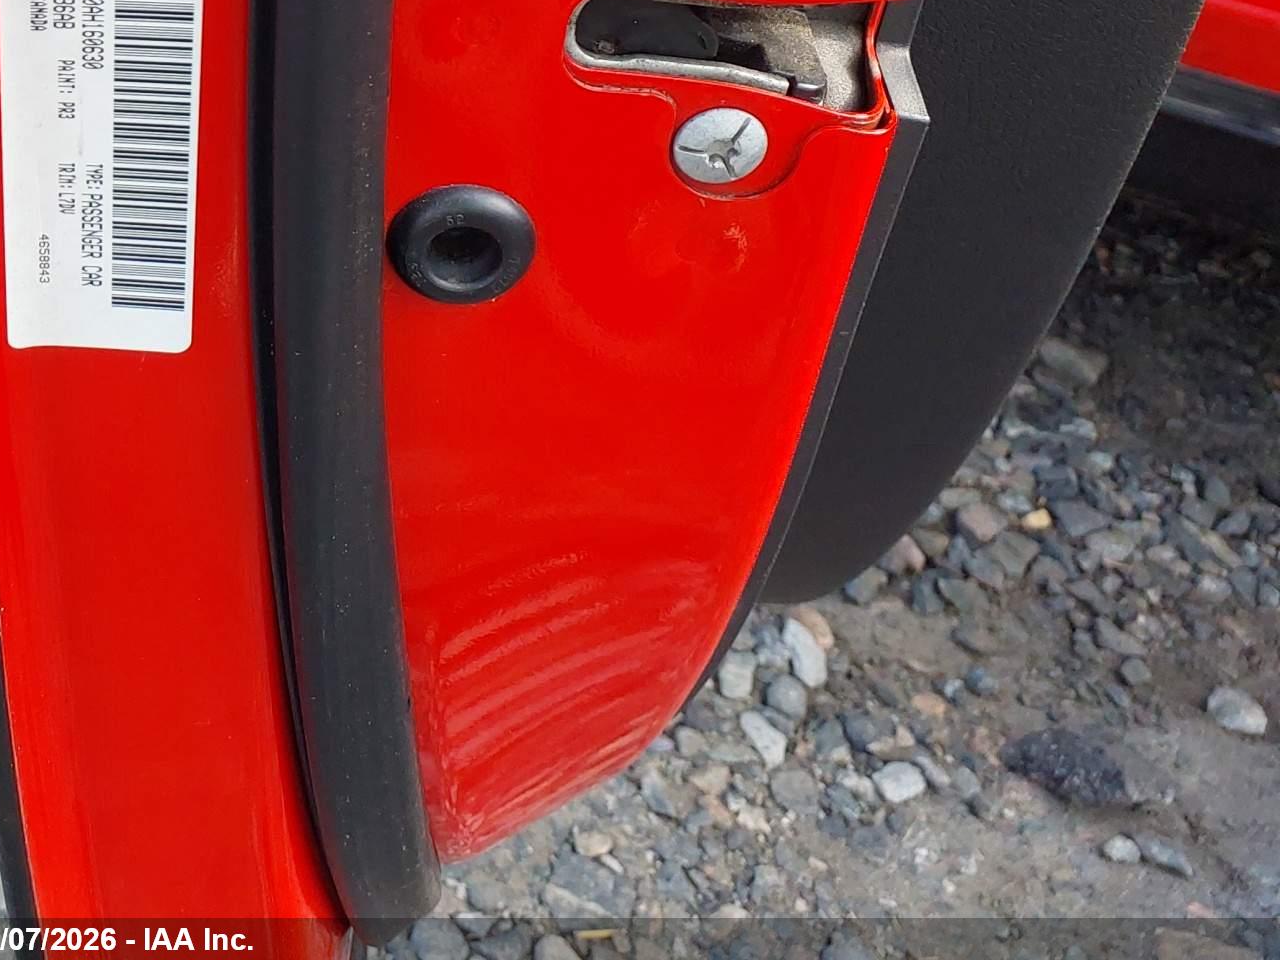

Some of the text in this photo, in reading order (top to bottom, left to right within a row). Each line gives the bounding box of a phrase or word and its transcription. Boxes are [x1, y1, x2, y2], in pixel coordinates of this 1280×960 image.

[59, 60, 75, 119] PAINT: PR3
[59, 164, 75, 190] TRIM:
[82, 165, 103, 287] TYPE: PASSENGER CAR
[39, 234, 50, 284] 4658843
